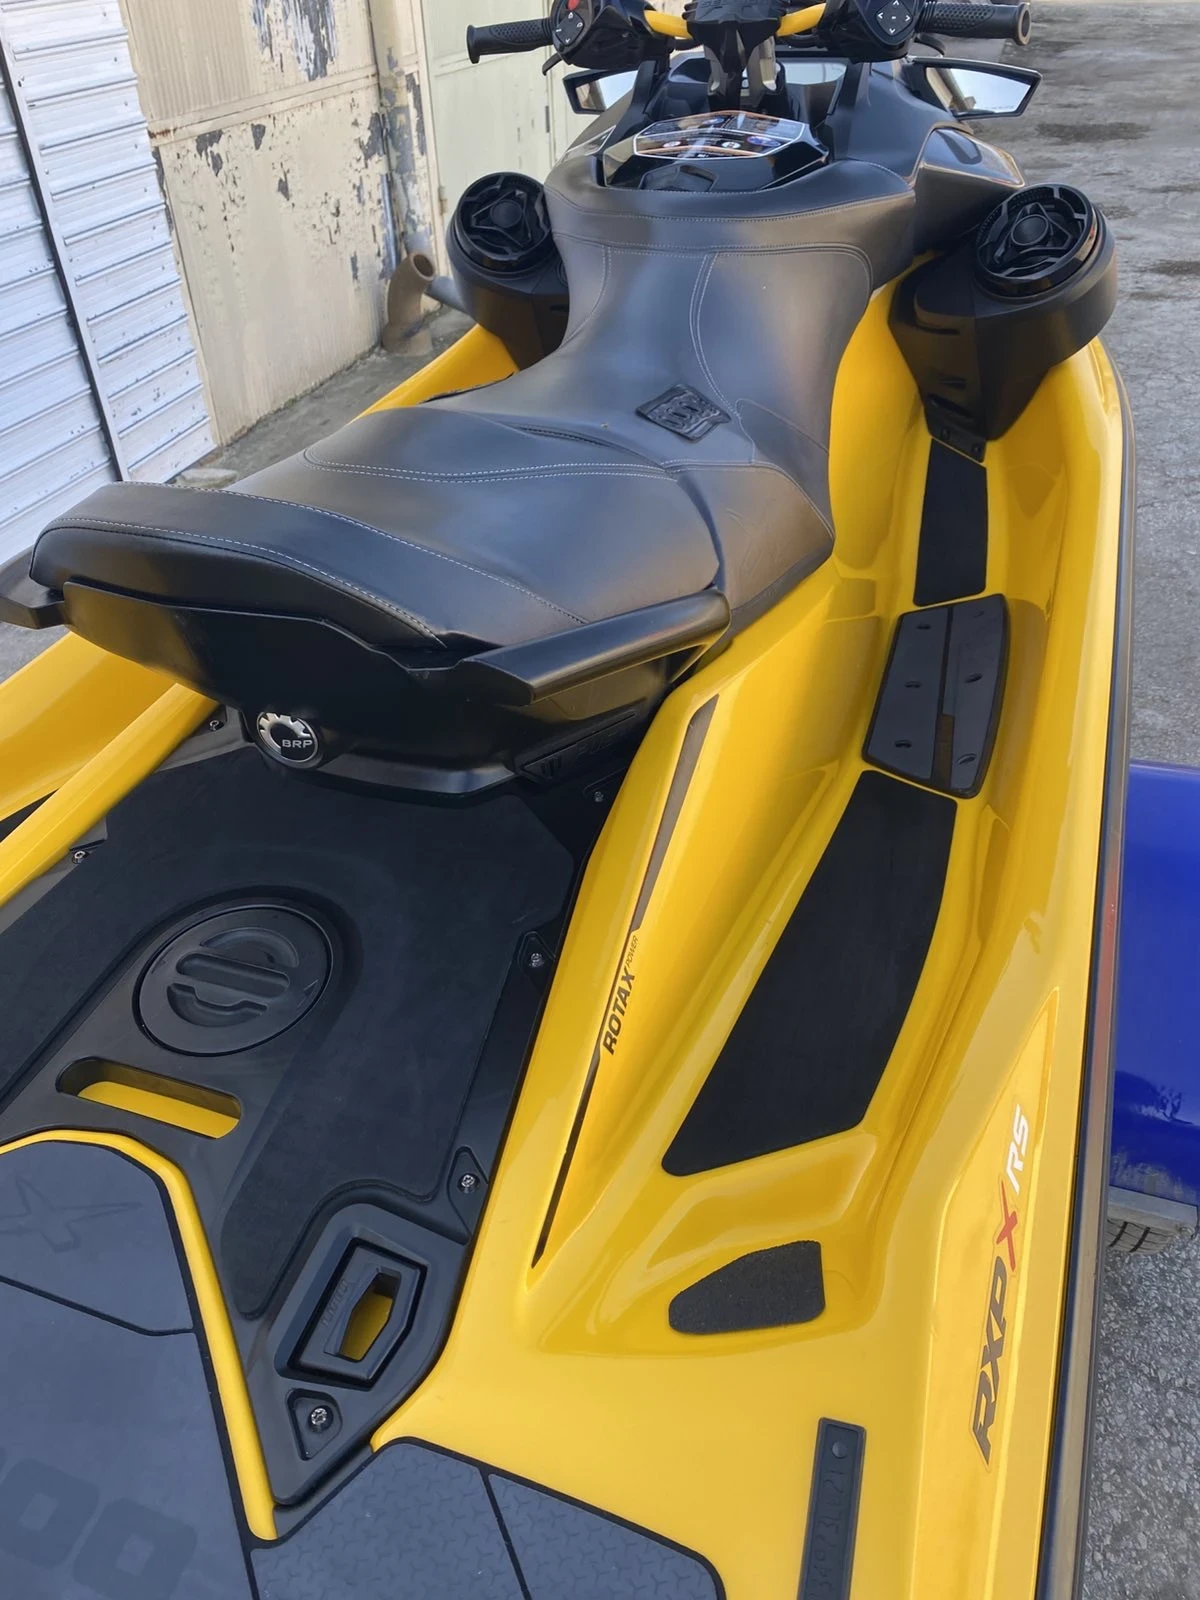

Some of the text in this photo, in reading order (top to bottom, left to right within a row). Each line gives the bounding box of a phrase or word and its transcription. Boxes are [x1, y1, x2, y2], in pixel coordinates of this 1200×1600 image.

[282, 739, 313, 748] BRP
[602, 935, 639, 1056] ROTAX POWER
[1005, 1103, 1029, 1196] RS
